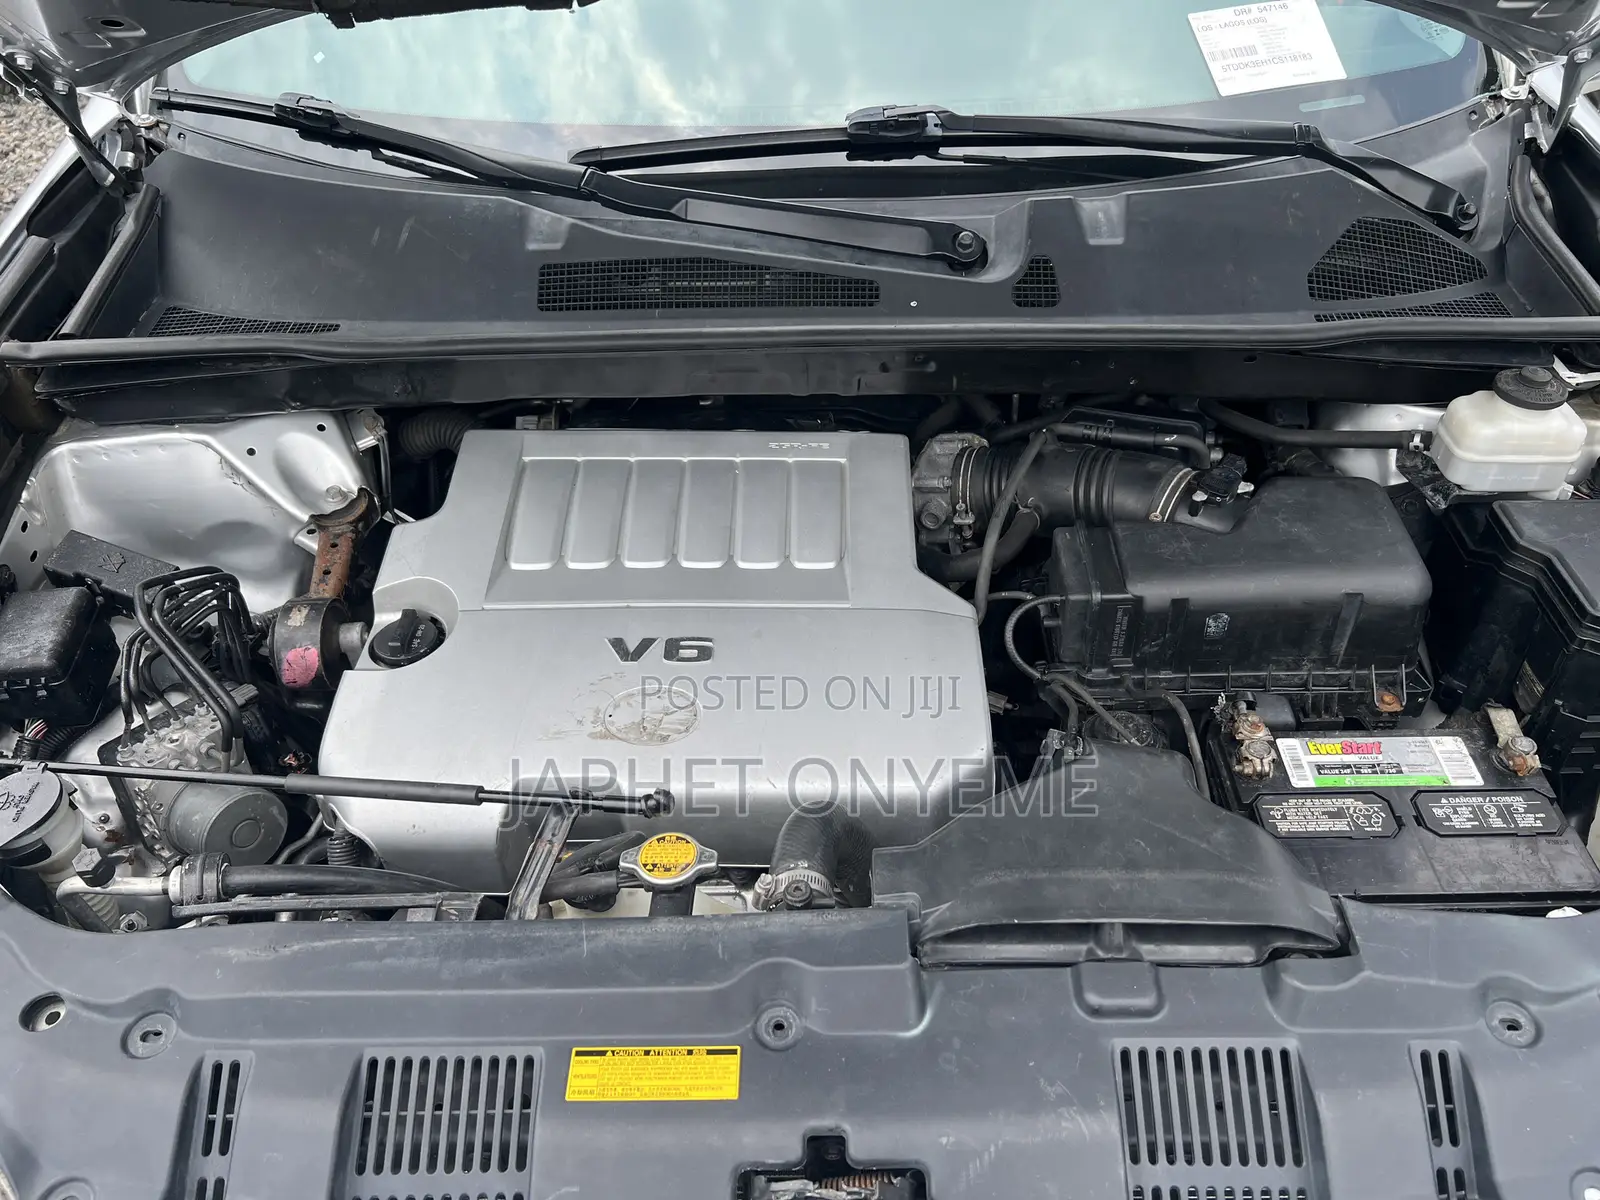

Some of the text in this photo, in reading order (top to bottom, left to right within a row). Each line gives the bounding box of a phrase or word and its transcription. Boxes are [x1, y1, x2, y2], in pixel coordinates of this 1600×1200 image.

[1233, 7, 1252, 17] DR#
[1218, 19, 1245, 29] LAGOS
[604, 636, 714, 664] V6
[1307, 741, 1382, 755] EverStart
[1448, 796, 1484, 804] DANGER
